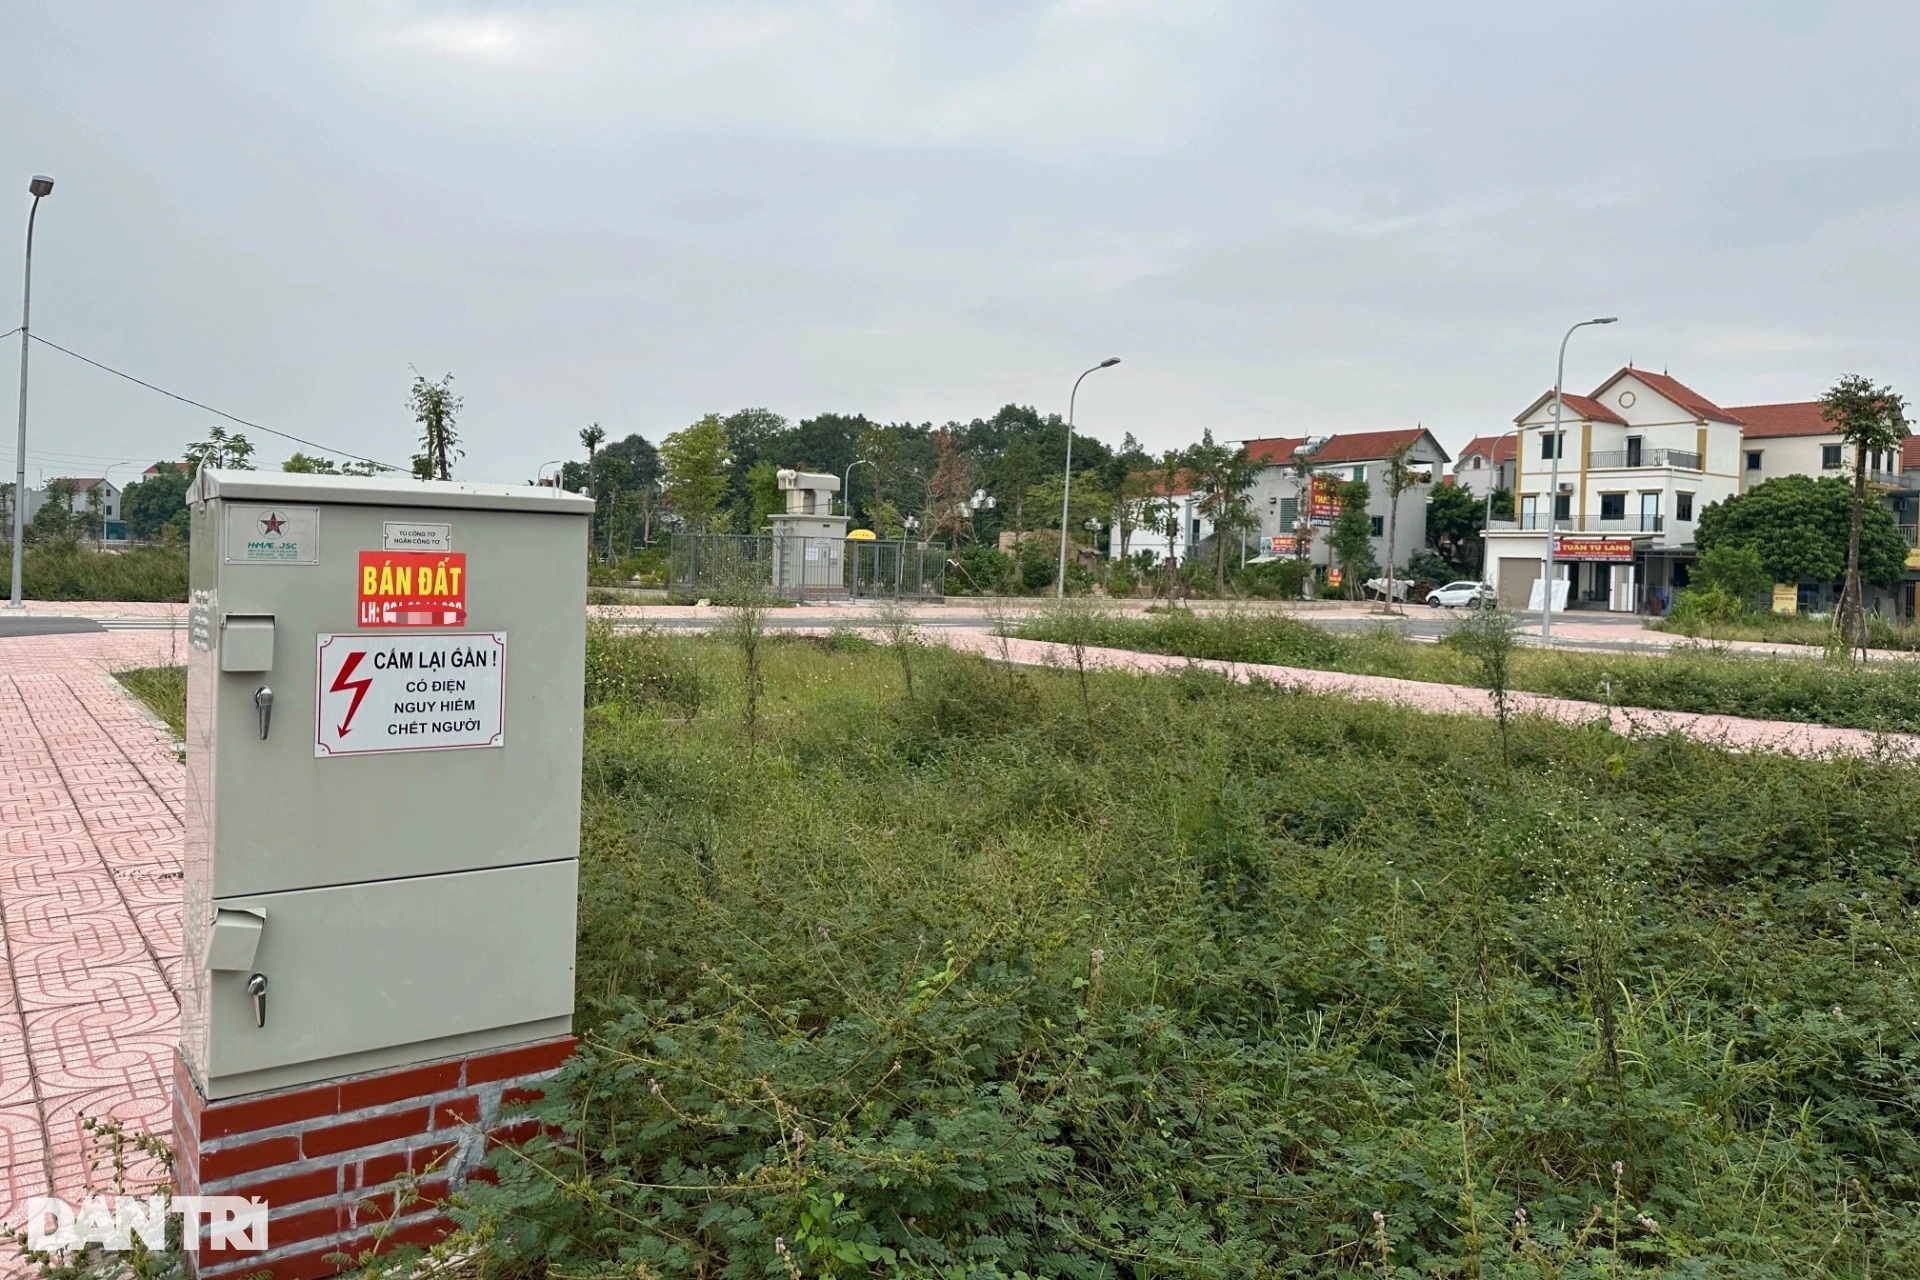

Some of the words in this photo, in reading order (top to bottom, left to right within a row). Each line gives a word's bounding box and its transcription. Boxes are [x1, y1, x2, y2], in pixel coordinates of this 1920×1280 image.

[363, 559, 412, 596] BÁN
[418, 556, 462, 596] ĐẤT
[361, 601, 380, 623] LH:
[419, 651, 446, 672] LẠI
[406, 678, 428, 693] CÓ
[432, 678, 466, 694] ĐIỆN
[394, 701, 437, 713] NGUY
[432, 718, 481, 733] NGƯỜI
